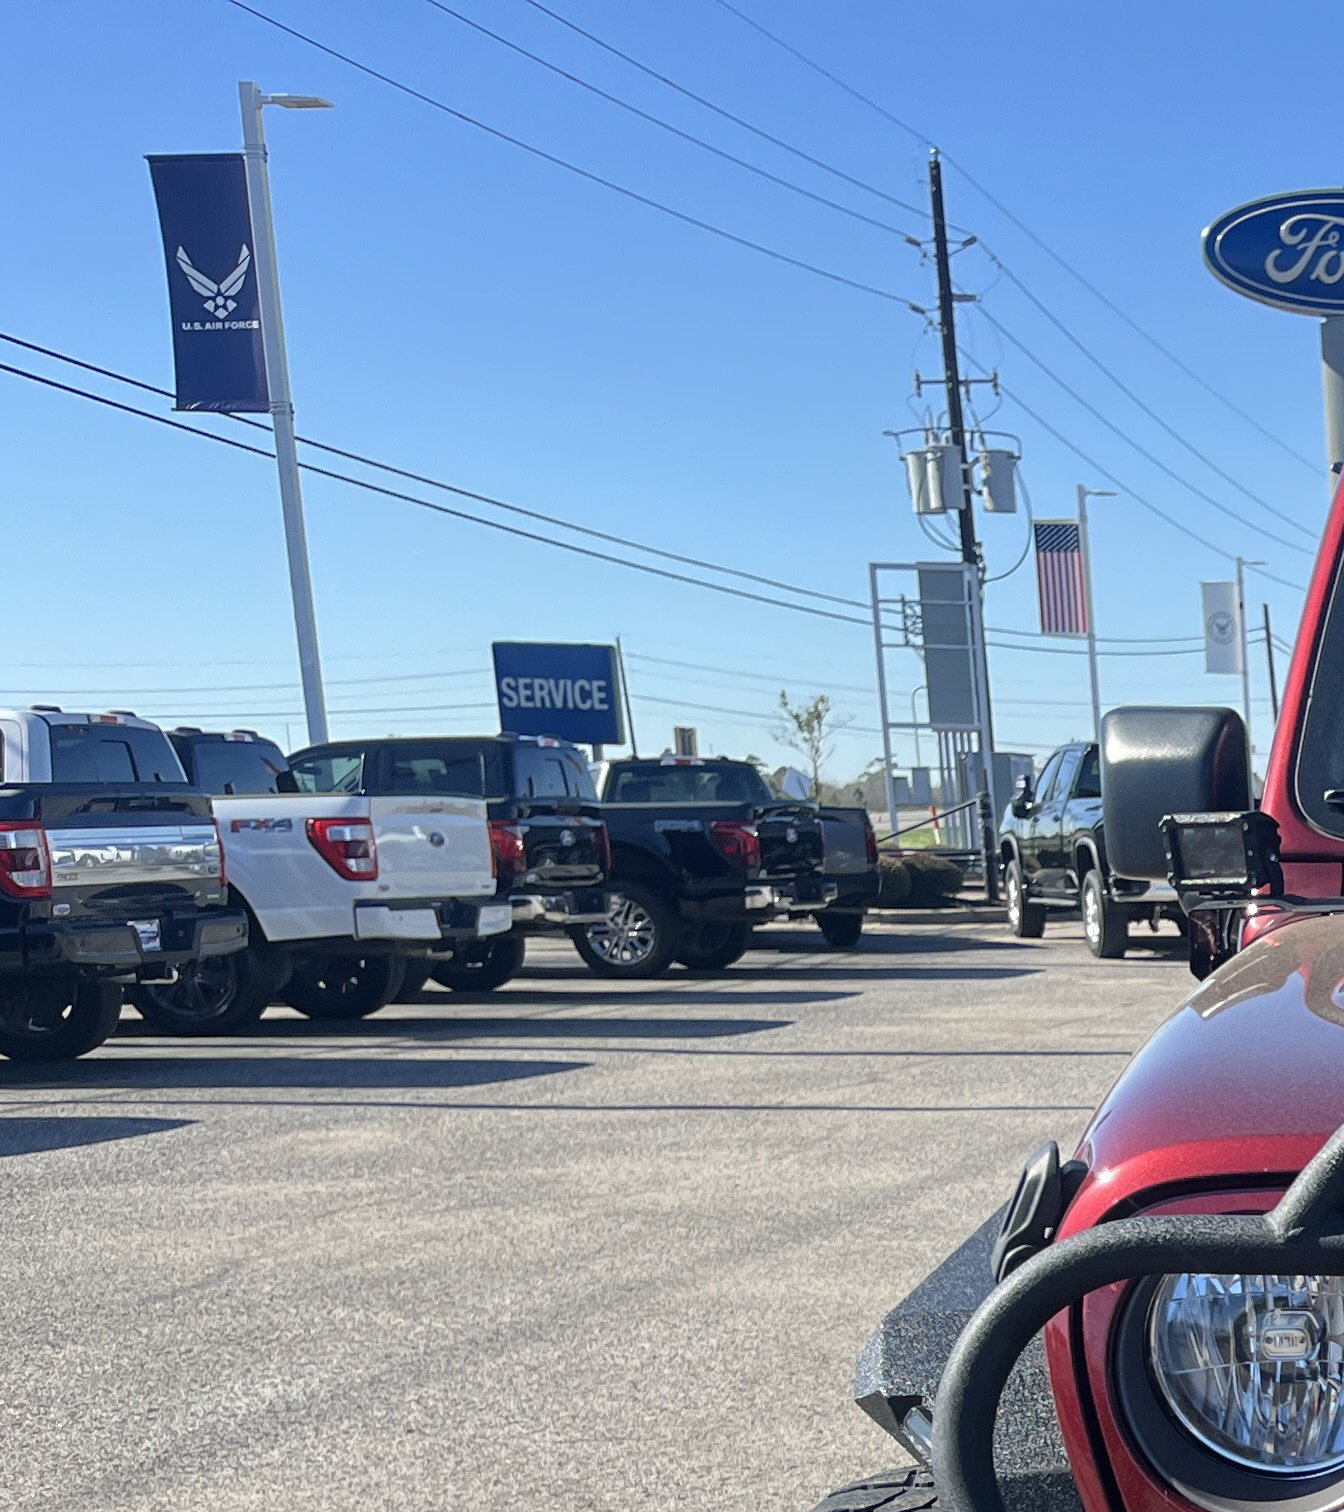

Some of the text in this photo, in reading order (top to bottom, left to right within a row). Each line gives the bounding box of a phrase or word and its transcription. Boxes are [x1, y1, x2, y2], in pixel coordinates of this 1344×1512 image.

[181, 320, 260, 331] U.S. AIR FORCE
[501, 676, 610, 711] SERVICE
